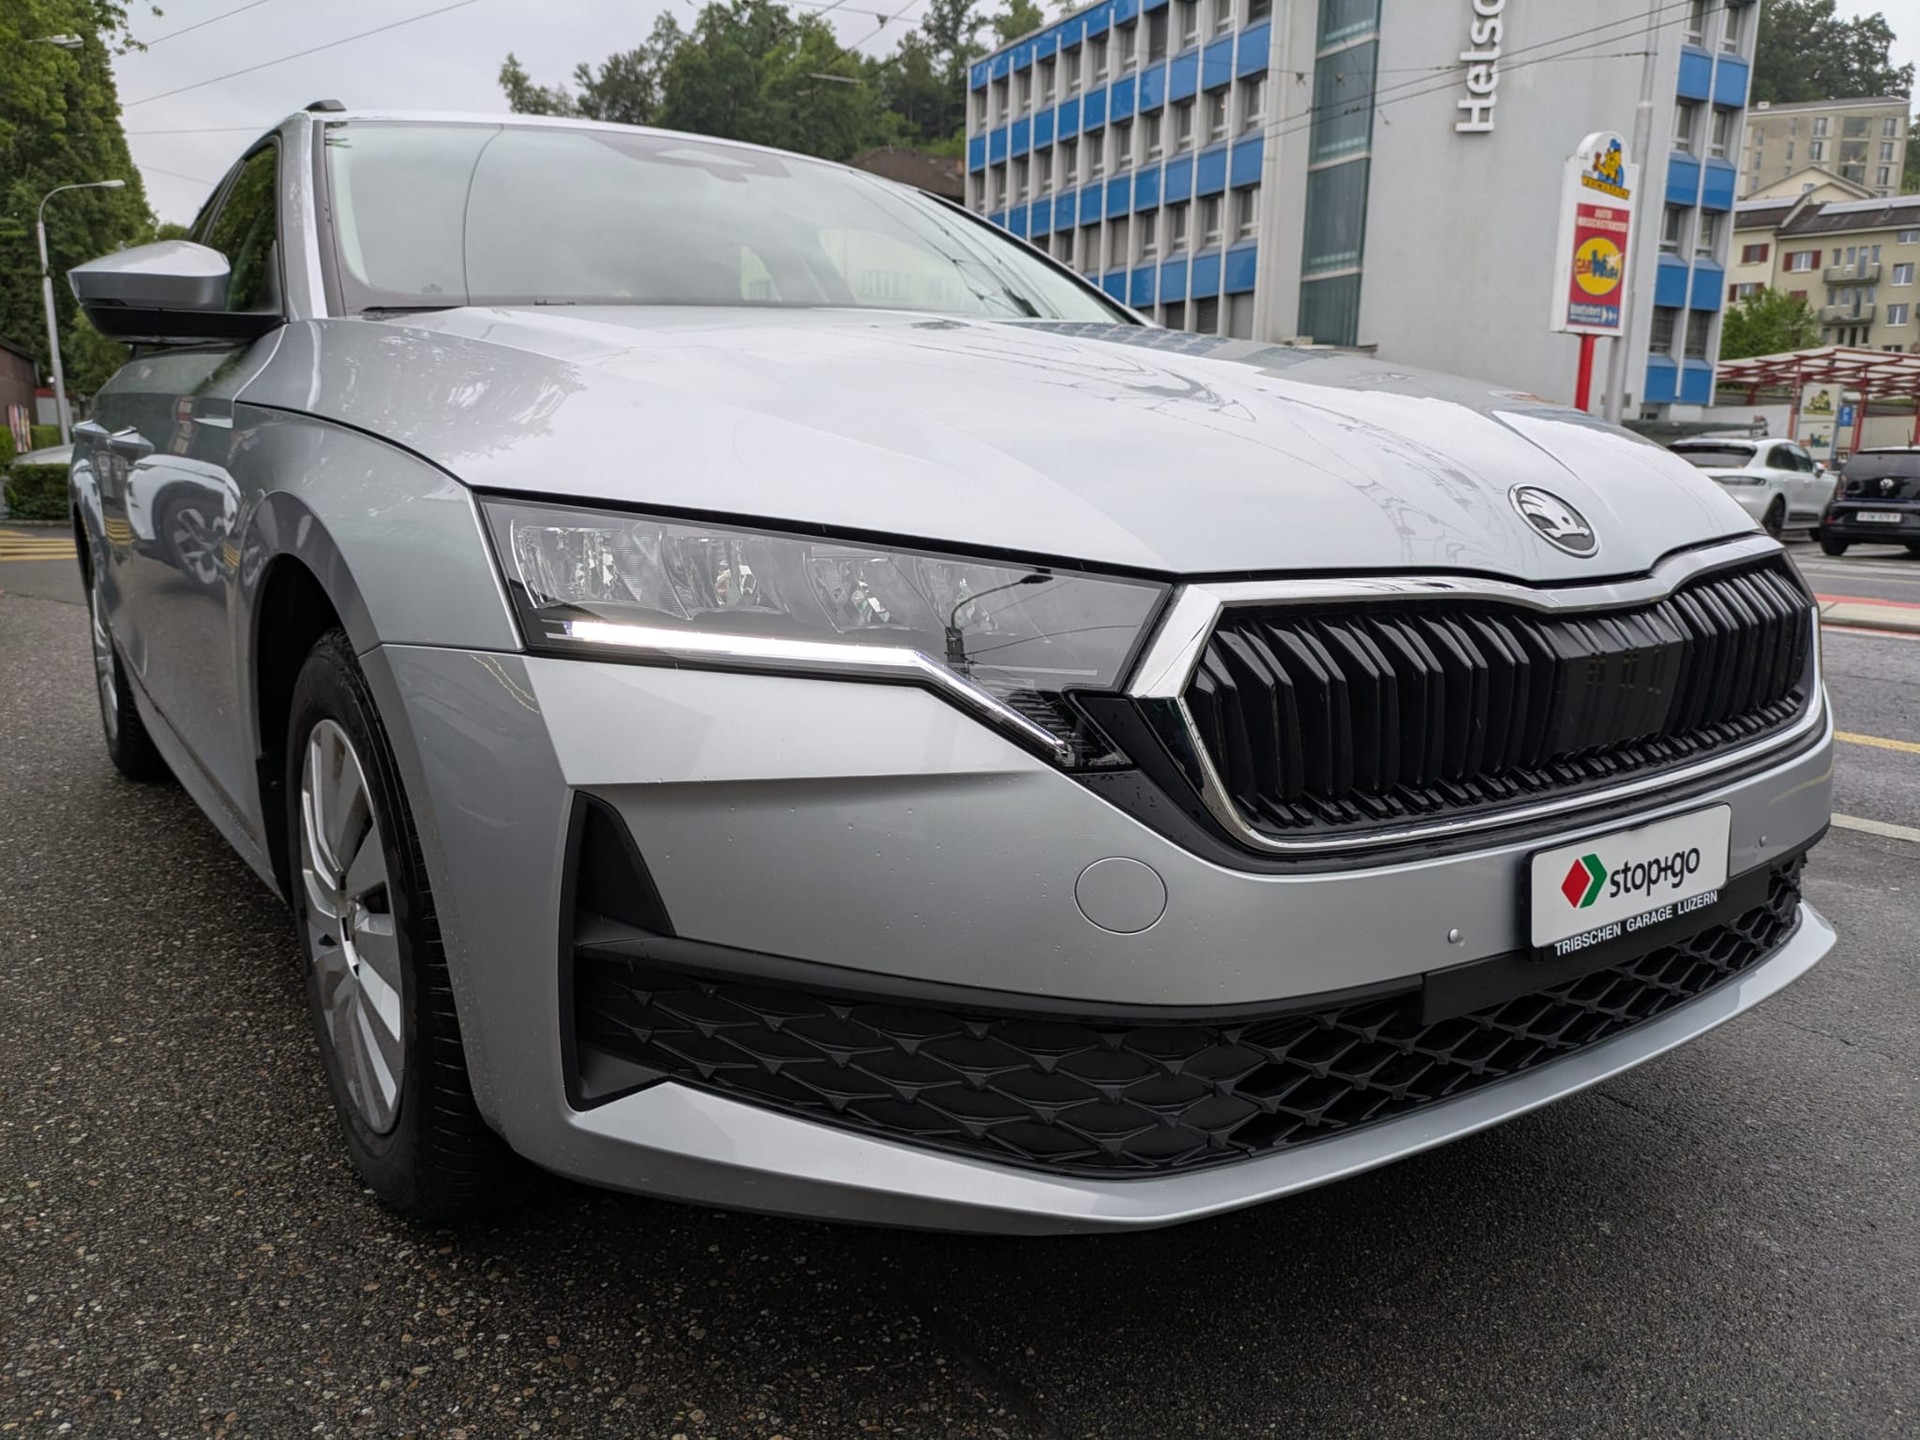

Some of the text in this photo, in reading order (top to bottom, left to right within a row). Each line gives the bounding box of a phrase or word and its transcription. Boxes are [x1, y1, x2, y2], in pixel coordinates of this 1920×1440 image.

[1609, 847, 1700, 898] stop+go
[1554, 890, 1718, 956] TRIBSCHEN GARAGE LUZERN
